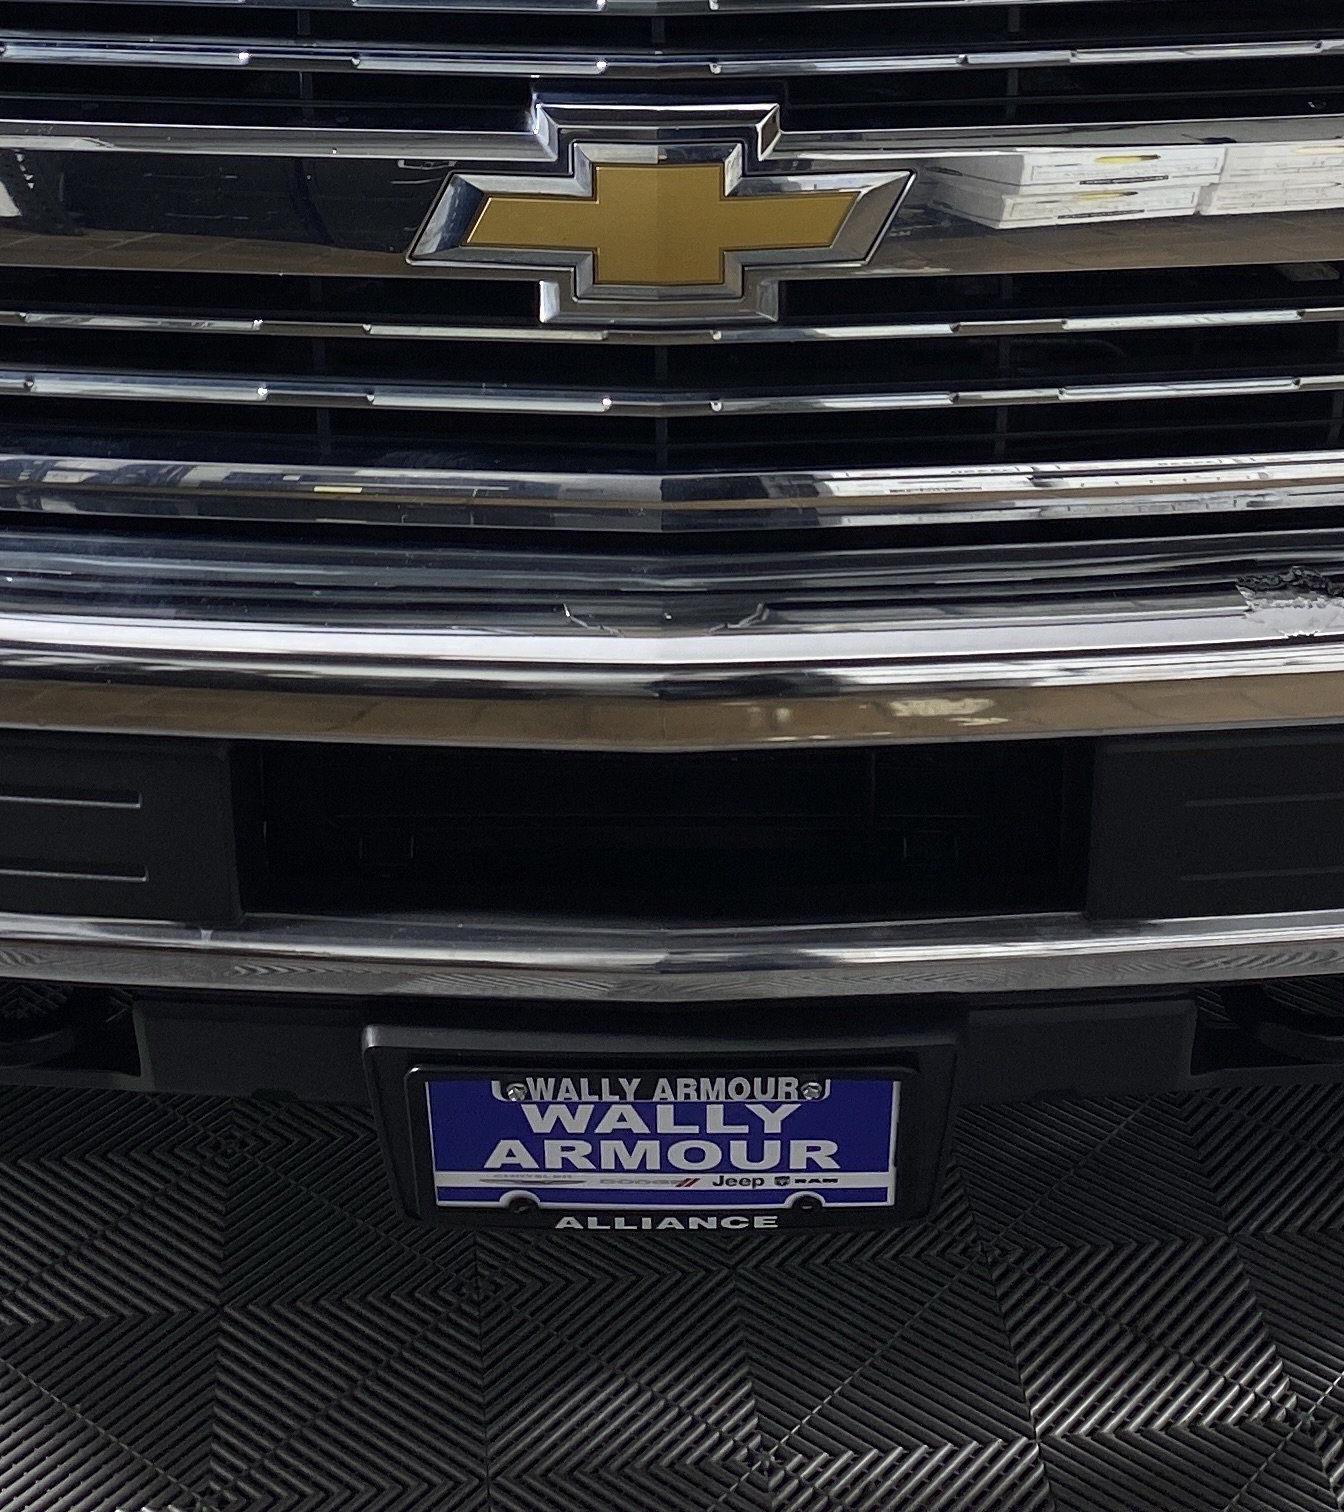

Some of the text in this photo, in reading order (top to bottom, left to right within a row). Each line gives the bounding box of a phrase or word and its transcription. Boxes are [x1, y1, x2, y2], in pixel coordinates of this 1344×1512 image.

[525, 1077, 799, 1100] WALLY ARMOUR
[521, 1104, 801, 1134] WALLY
[483, 1139, 841, 1170] ARMOUR
[712, 1175, 765, 1189] Jeep
[555, 1216, 779, 1230] ALLIANCE
